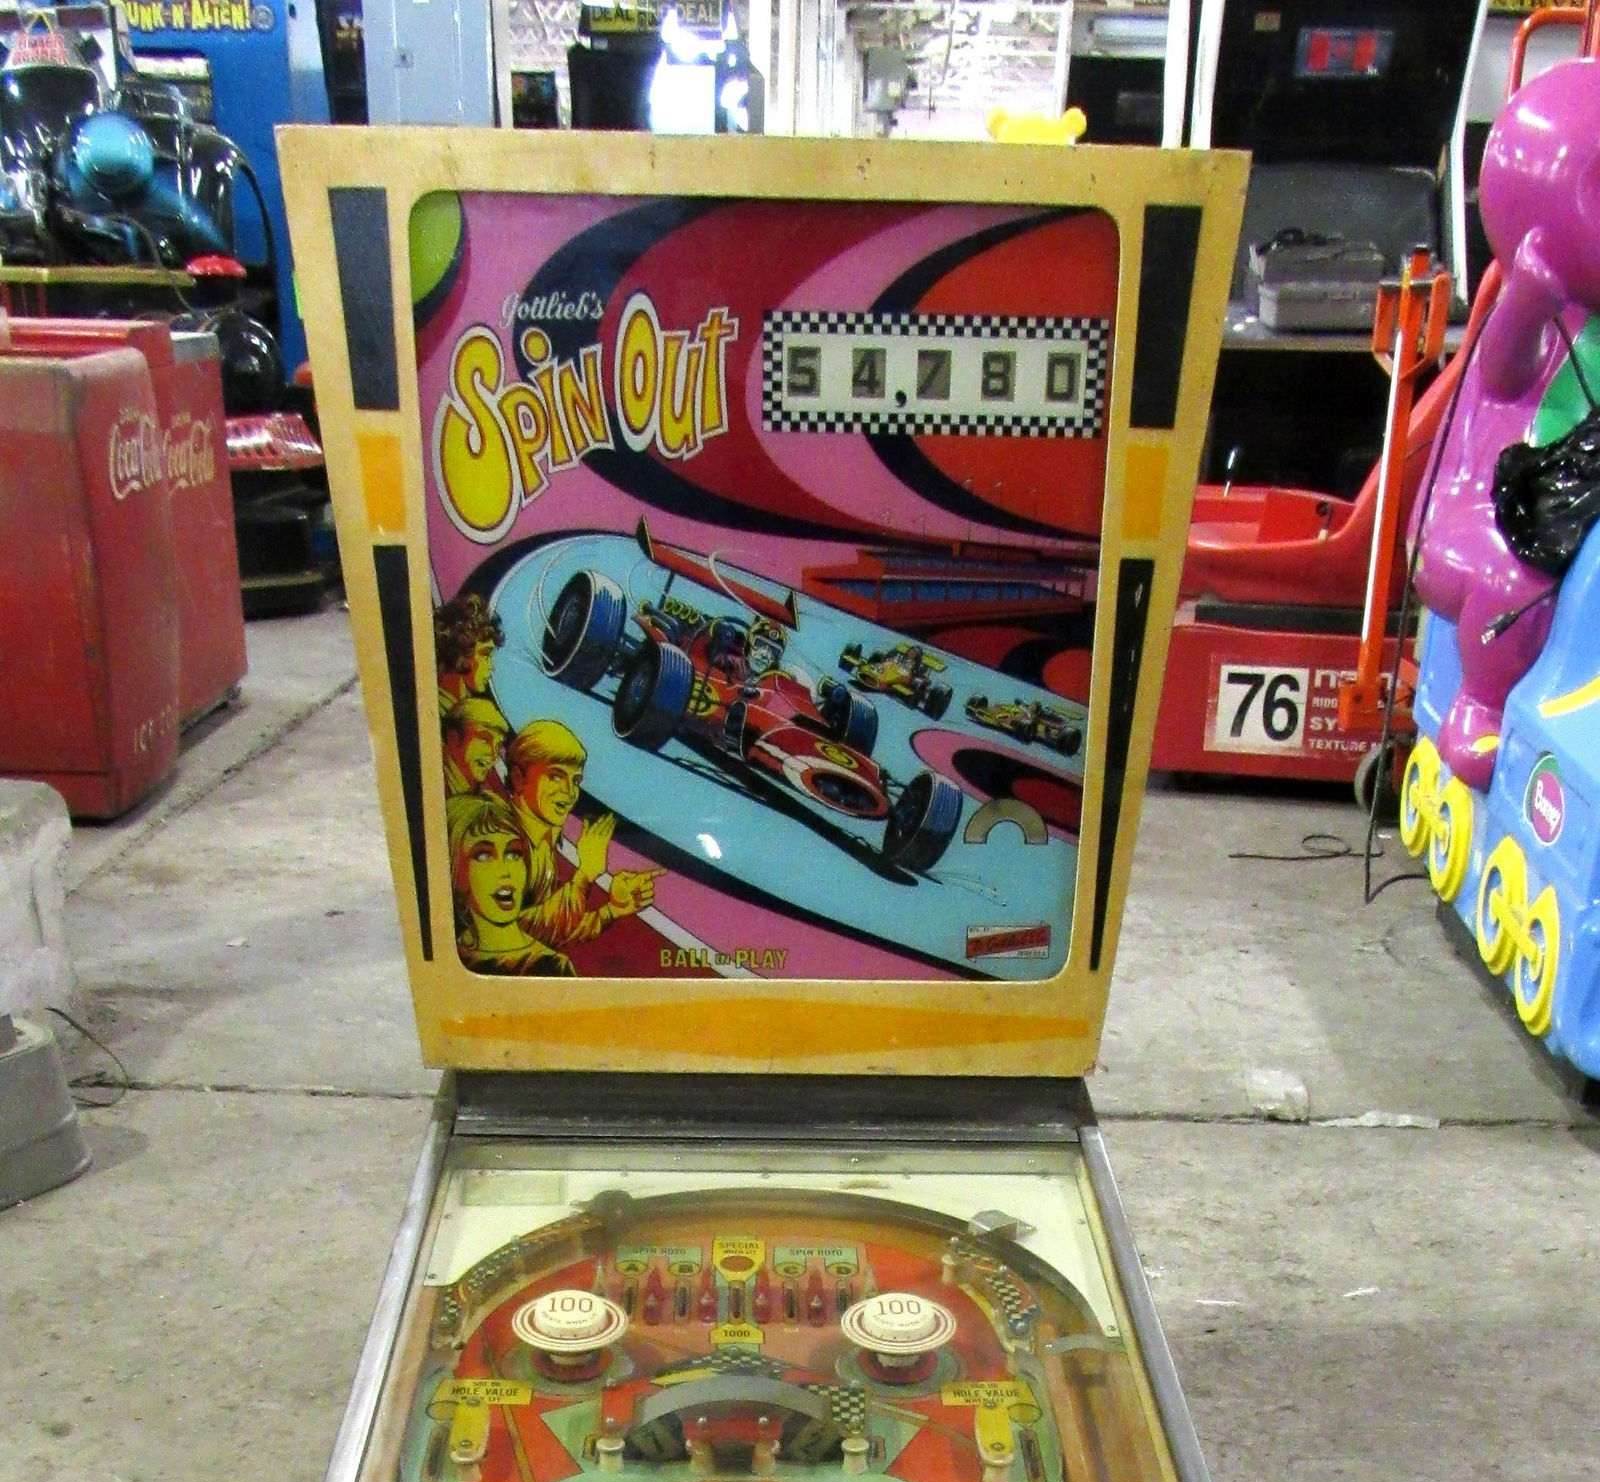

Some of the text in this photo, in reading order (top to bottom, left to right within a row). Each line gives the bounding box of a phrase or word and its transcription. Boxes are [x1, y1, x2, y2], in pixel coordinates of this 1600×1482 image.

[501, 291, 604, 328] Gottlieb's
[1226, 671, 1301, 741] 76
[1312, 697, 1338, 708] RIDG
[1308, 738, 1367, 751] TEXTURE
[1534, 779, 1562, 835] Barney
[659, 948, 789, 970] BALL IN PLAY
[717, 1241, 761, 1250] SPECIAL
[548, 1296, 593, 1313] 100
[877, 1299, 921, 1316] 100
[723, 1329, 751, 1338] 1000
[451, 1386, 520, 1397] HOLE VALUE
[952, 1388, 1021, 1398] HOLE VALUE
